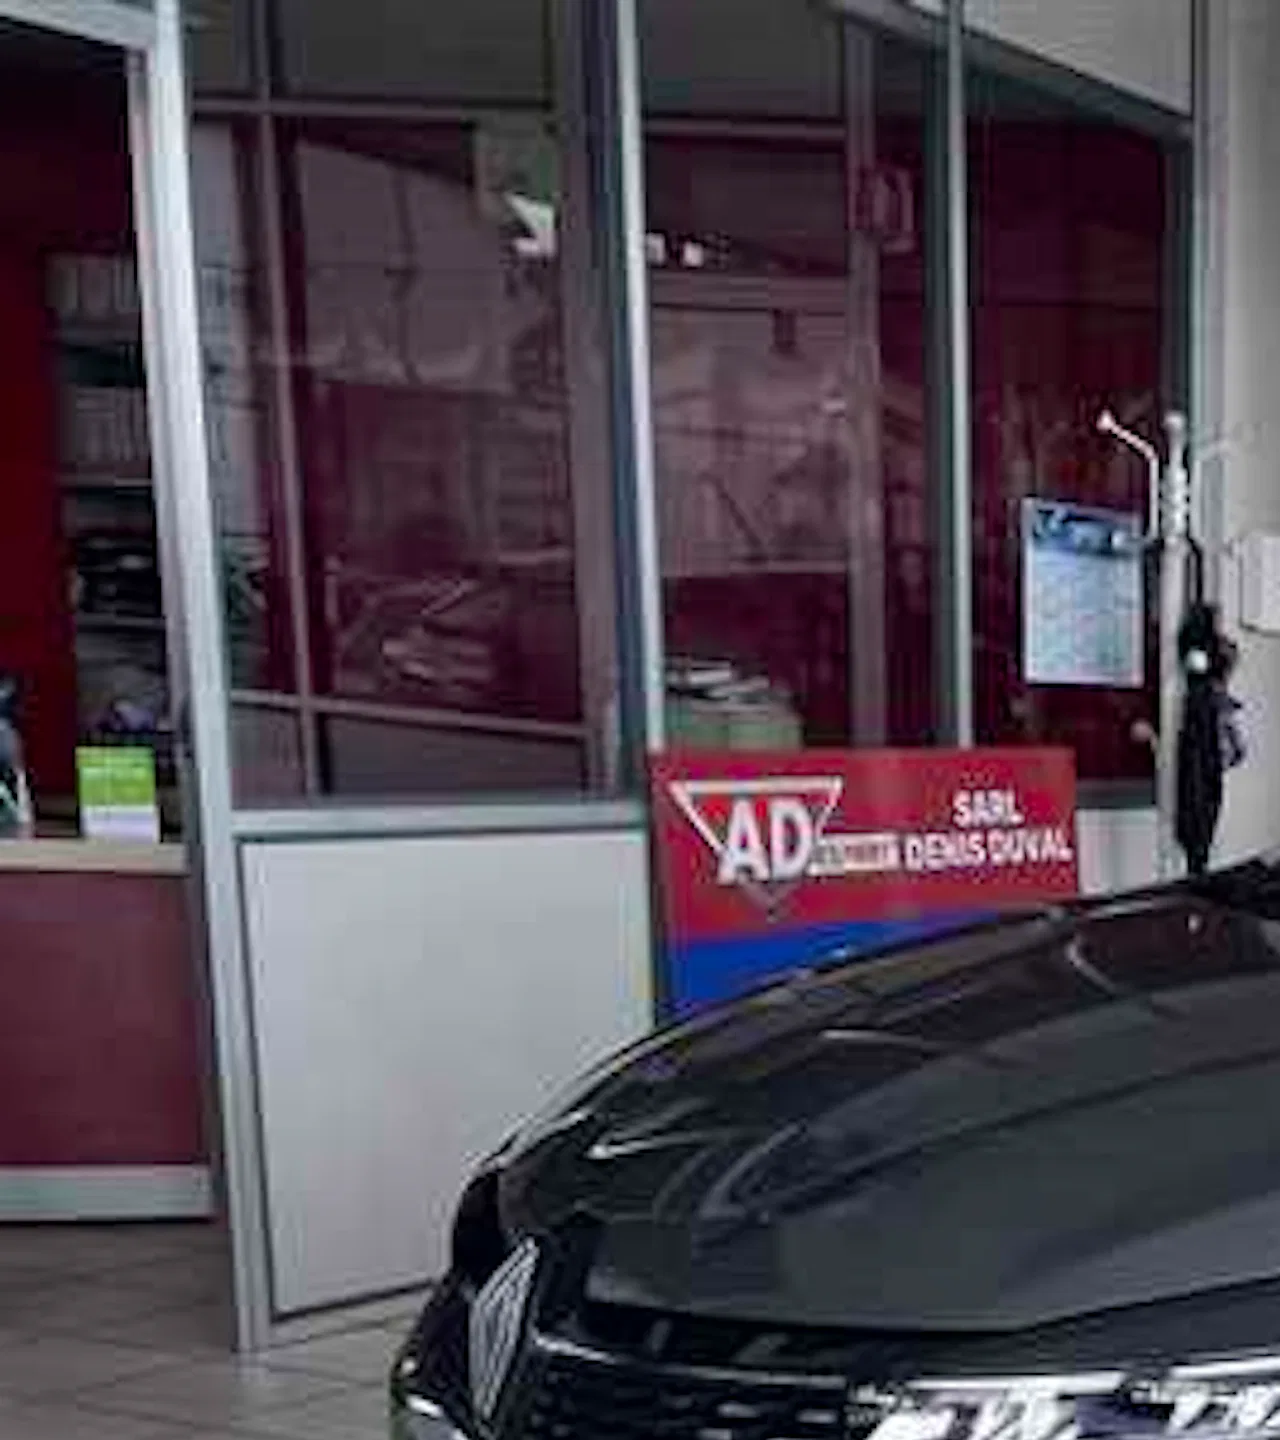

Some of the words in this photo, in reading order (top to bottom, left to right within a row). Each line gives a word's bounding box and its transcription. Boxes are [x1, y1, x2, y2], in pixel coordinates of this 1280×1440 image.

[952, 788, 1024, 827] SARL
[717, 797, 812, 886] AD
[904, 830, 987, 872] DENIS
[988, 826, 1073, 866] DUVAL
